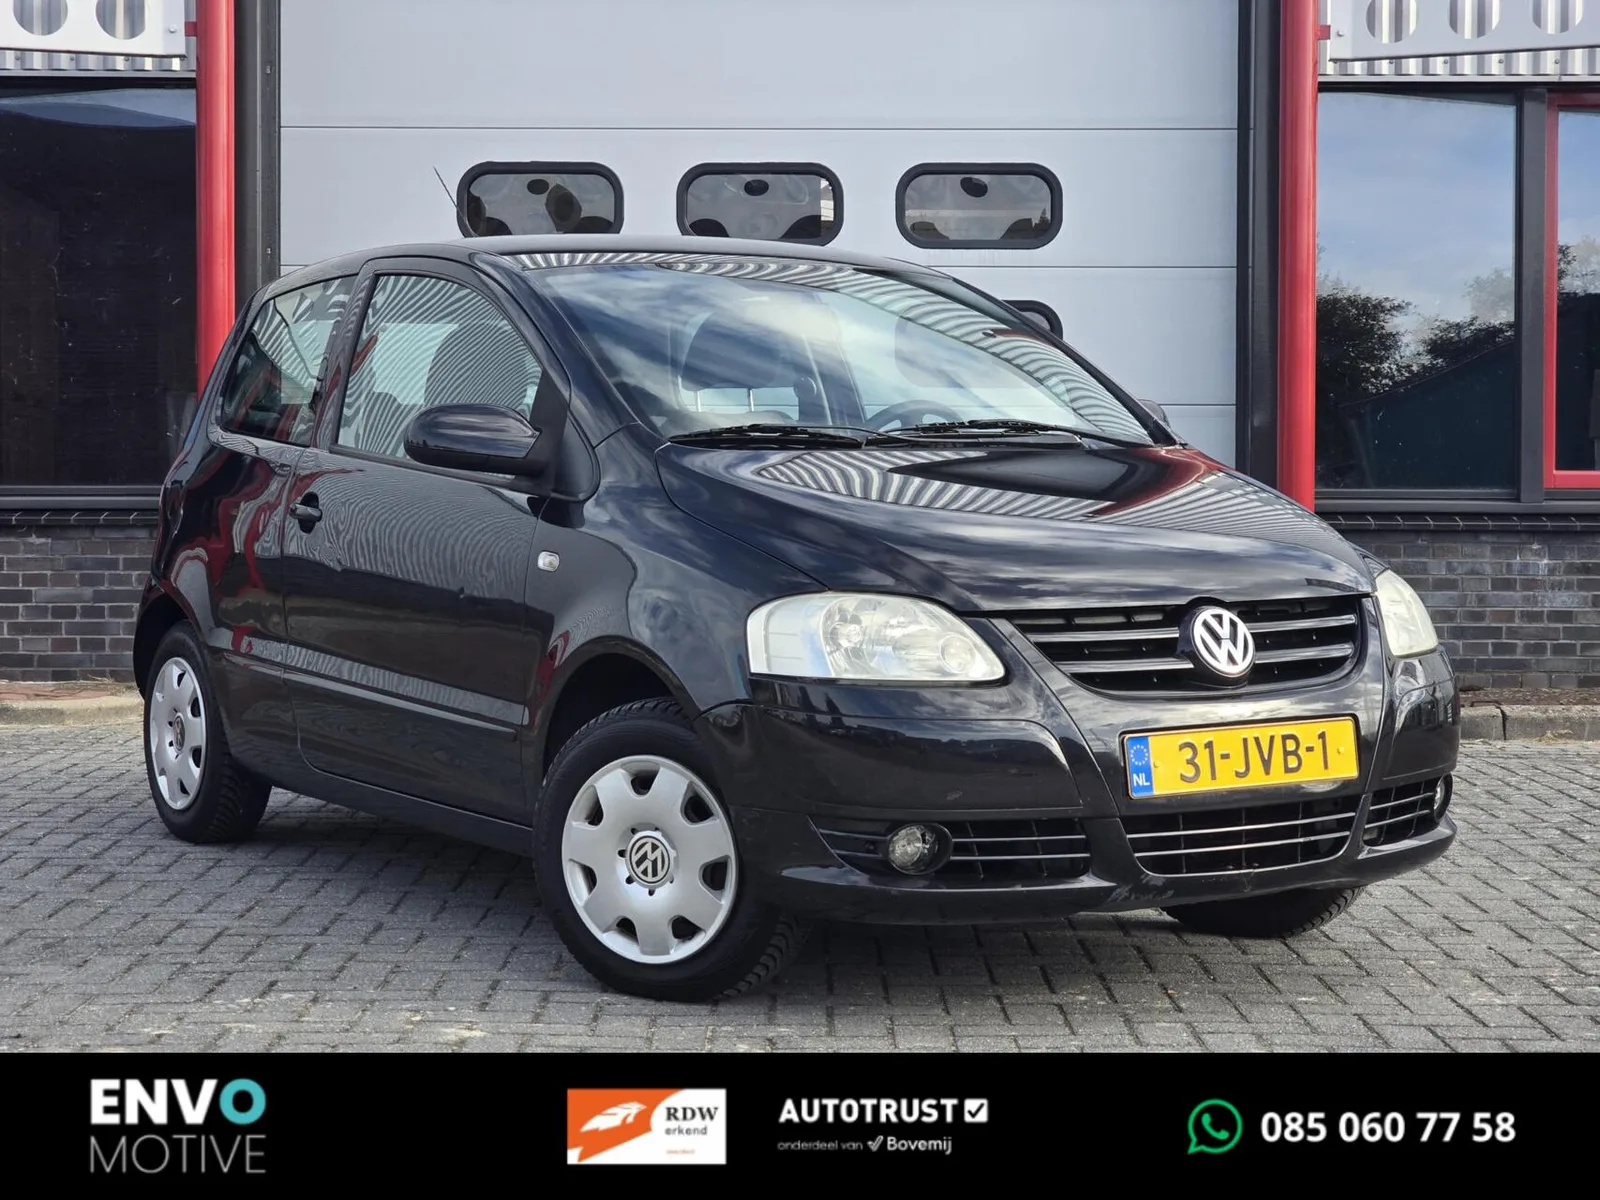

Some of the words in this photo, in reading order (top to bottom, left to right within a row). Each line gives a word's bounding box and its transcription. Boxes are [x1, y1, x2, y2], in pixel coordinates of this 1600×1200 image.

[1193, 608, 1254, 676] VW
[1133, 772, 1151, 787] NL
[1178, 730, 1329, 784] 31-JVB-1
